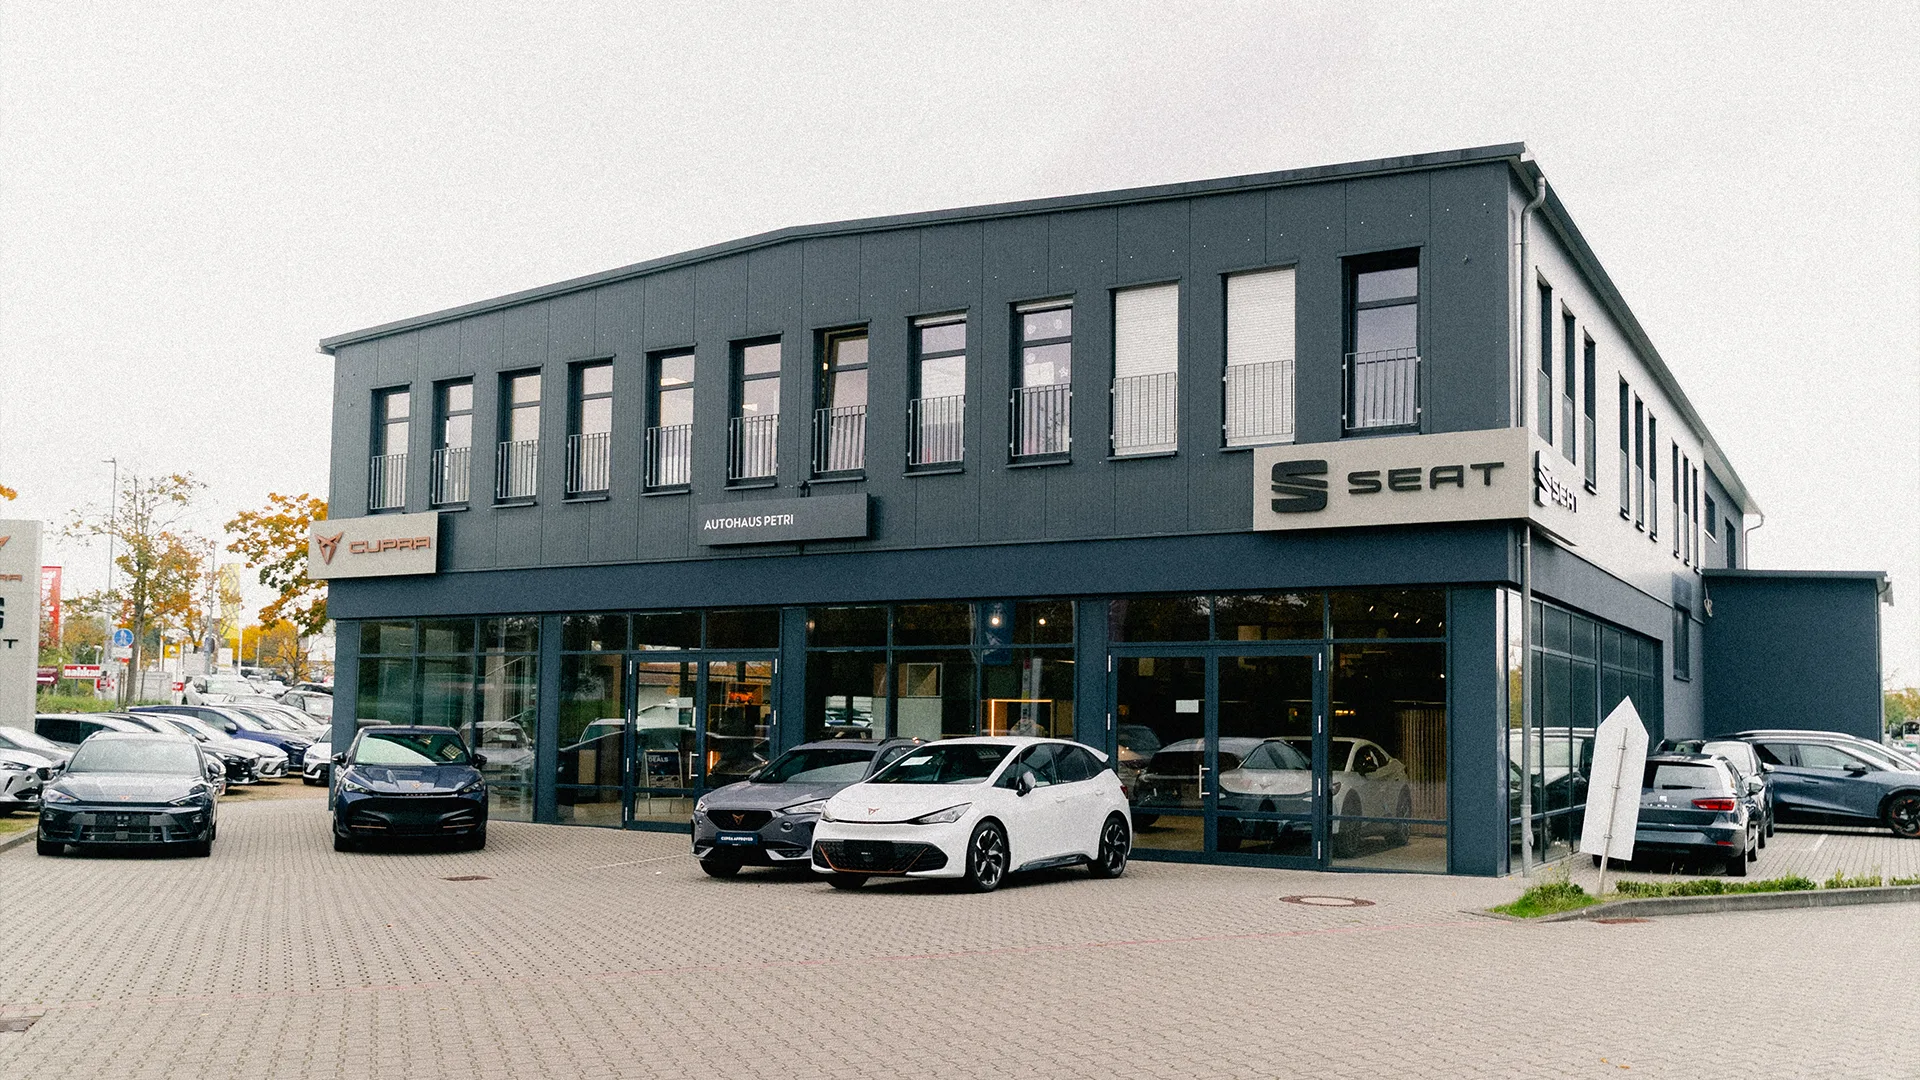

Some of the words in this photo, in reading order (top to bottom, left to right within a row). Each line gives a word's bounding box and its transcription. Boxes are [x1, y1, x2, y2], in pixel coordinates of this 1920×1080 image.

[1347, 462, 1505, 494] SEAT
[704, 516, 762, 530] AUTOHAUS
[763, 514, 794, 527] PETRI
[349, 536, 431, 554] CUPRA
[64, 666, 101, 677] nahkau
